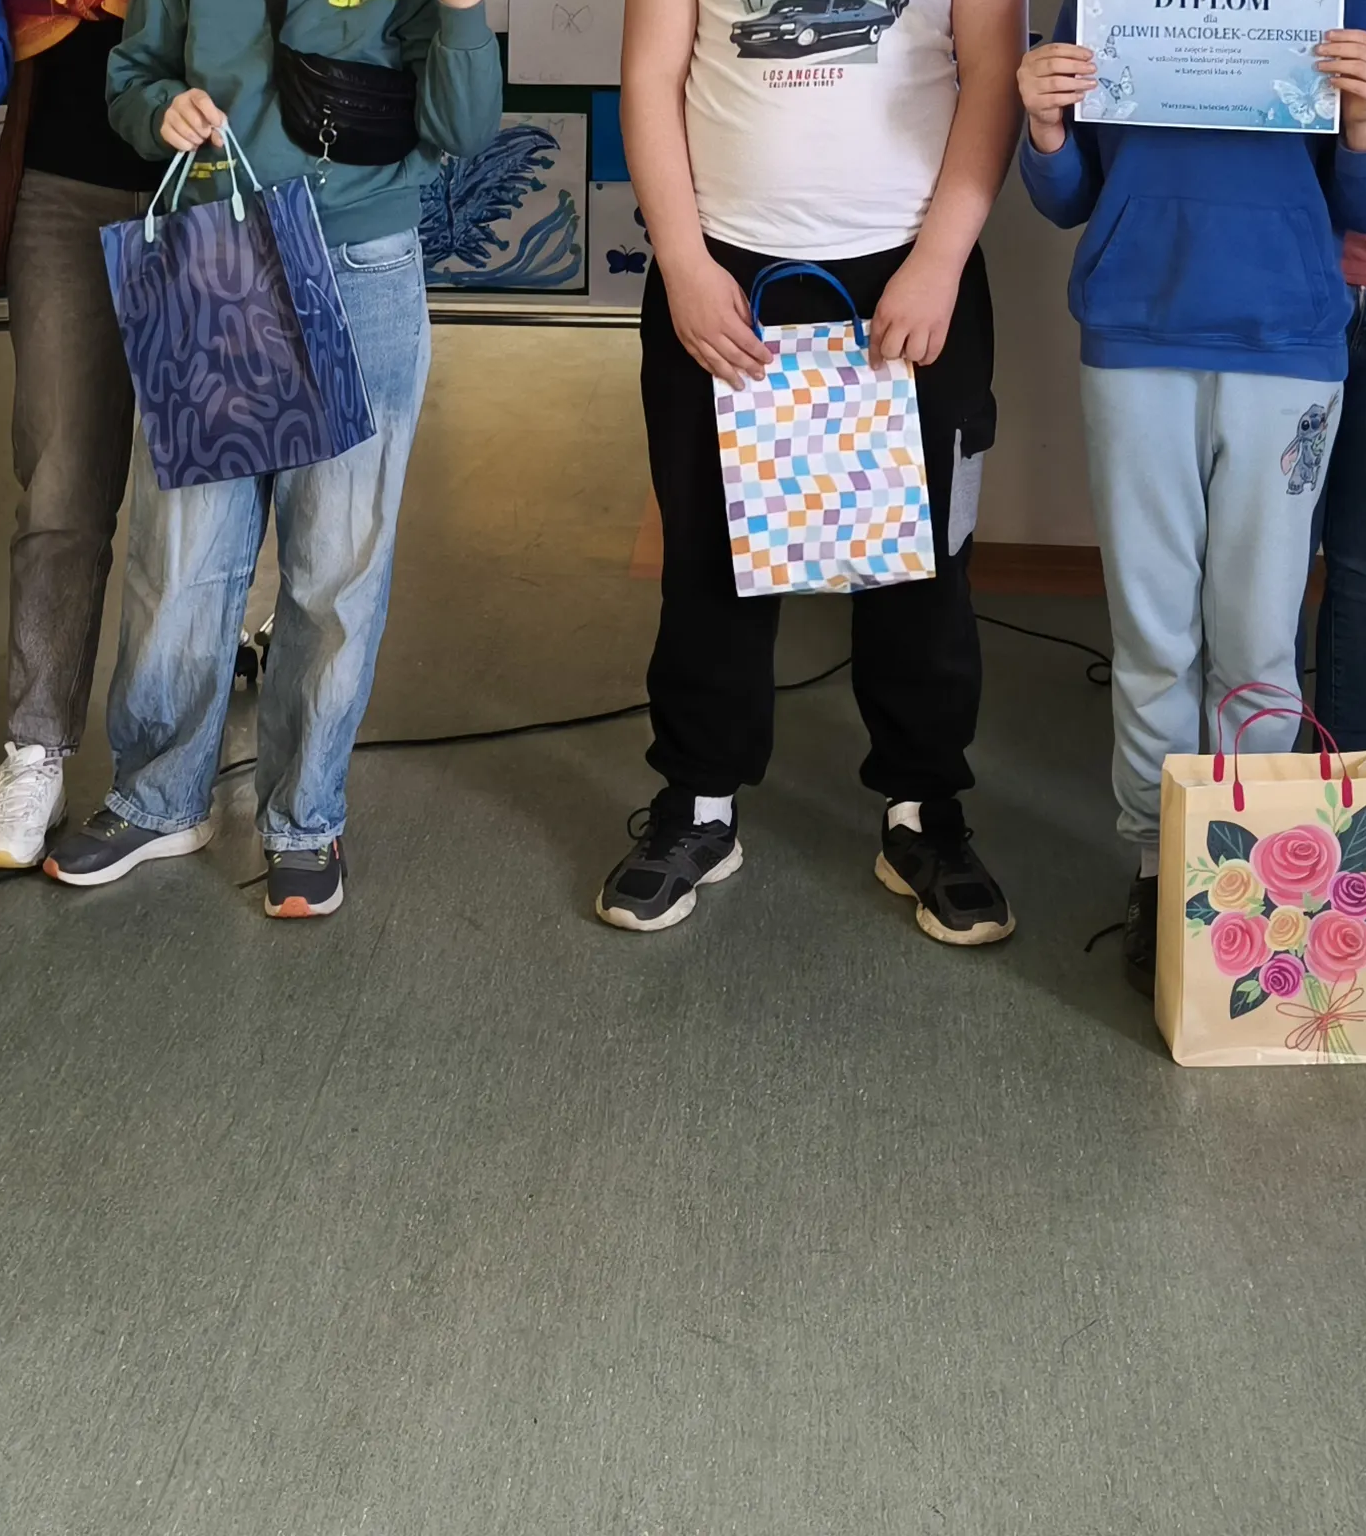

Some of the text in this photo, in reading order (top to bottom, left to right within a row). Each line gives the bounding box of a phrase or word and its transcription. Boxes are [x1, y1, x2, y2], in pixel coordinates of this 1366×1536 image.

[1203, 14, 1218, 24] dla
[1110, 24, 1160, 38] OLIWII
[1190, 55, 1224, 64] konkursie
[762, 68, 844, 81] LOS ANGELES
